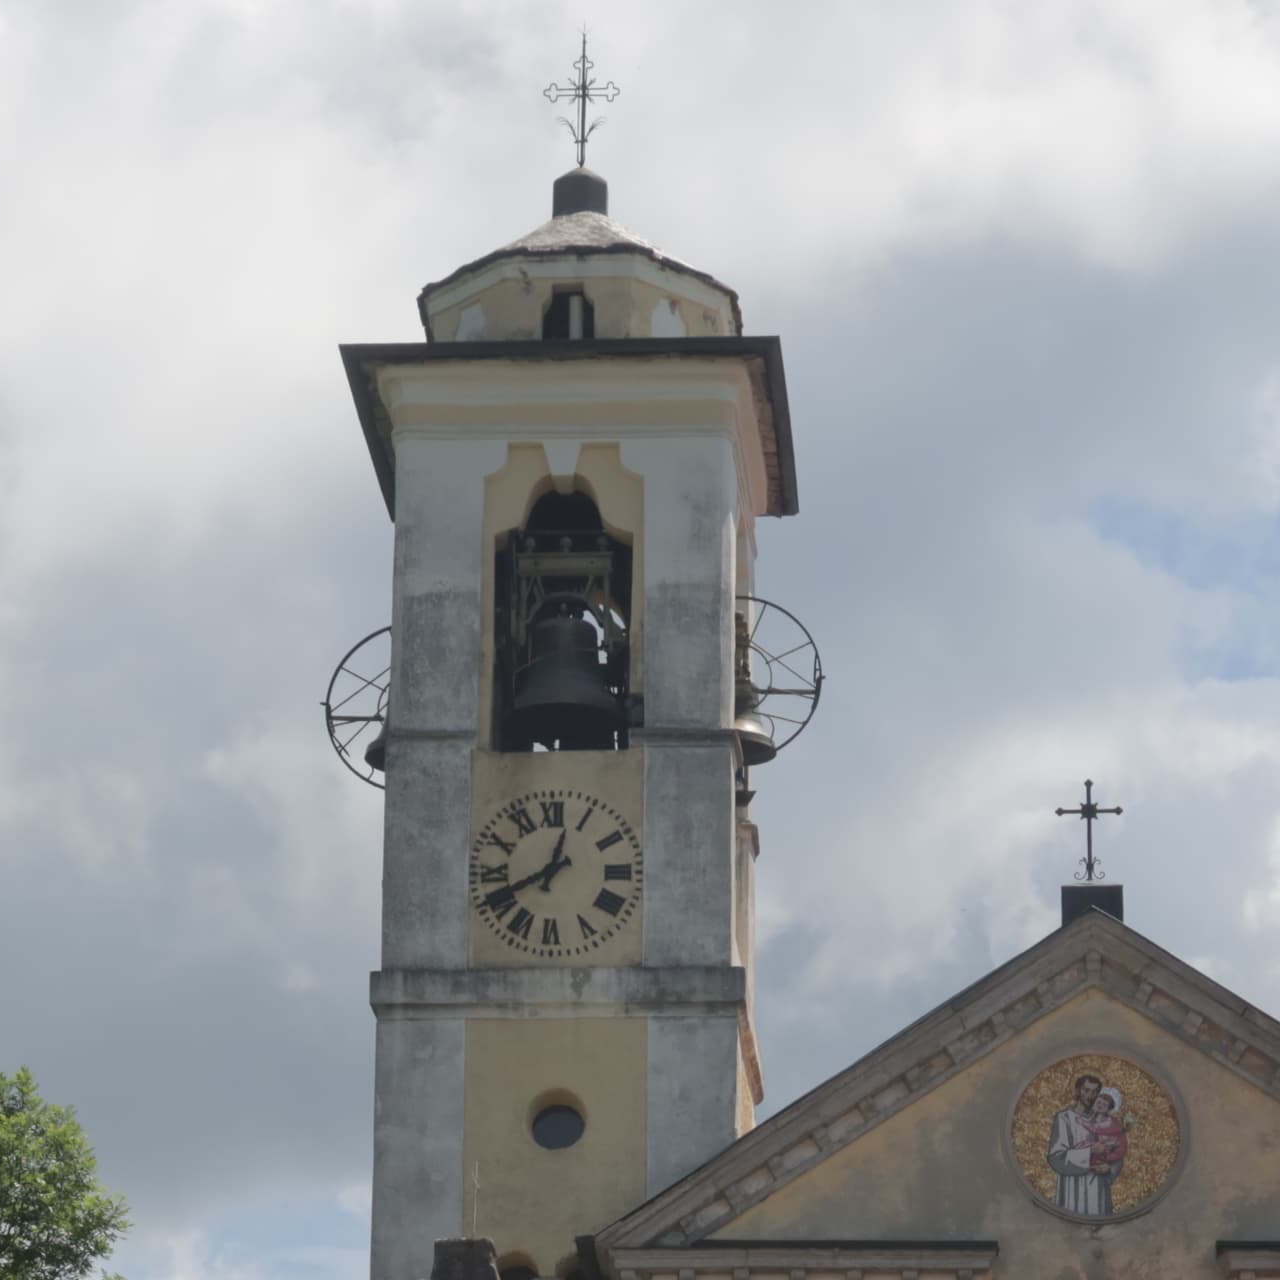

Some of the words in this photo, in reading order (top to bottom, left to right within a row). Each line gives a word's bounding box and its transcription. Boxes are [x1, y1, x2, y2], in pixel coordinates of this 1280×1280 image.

[507, 808, 537, 838] XI
[539, 802, 564, 827] XII
[575, 807, 593, 832] I
[487, 832, 517, 856] X
[595, 830, 624, 852] II
[480, 864, 509, 883] IX
[604, 864, 632, 881] III
[507, 907, 535, 940] VII
[542, 918, 560, 945] VI
[576, 913, 598, 939] V
